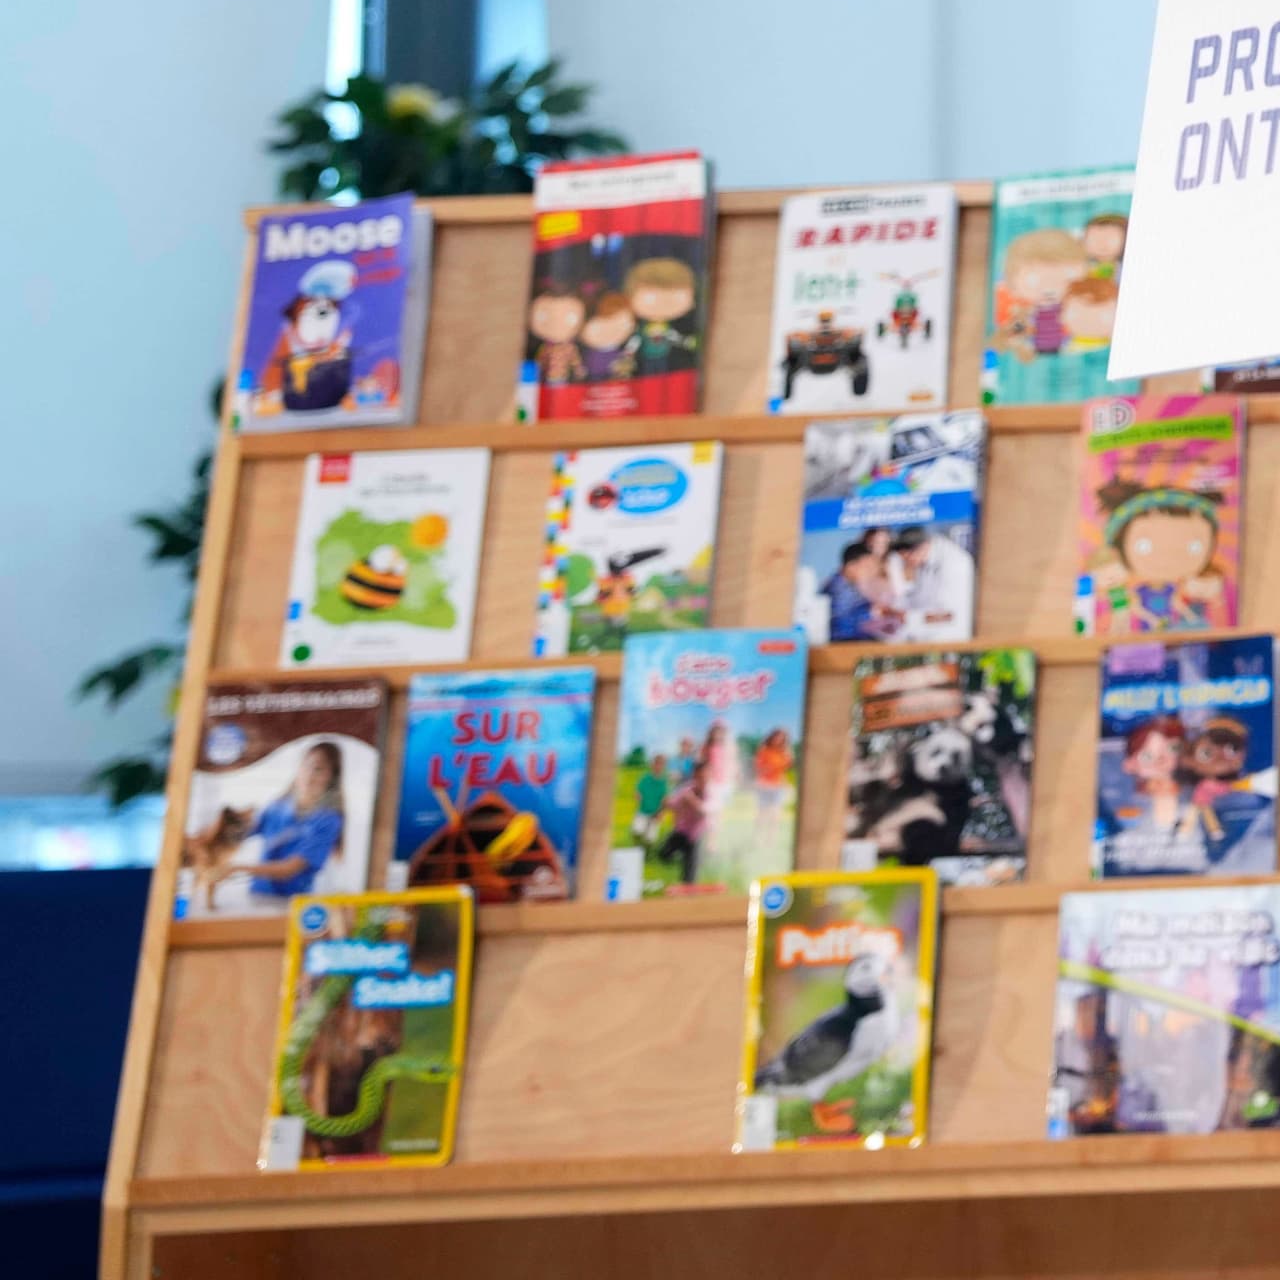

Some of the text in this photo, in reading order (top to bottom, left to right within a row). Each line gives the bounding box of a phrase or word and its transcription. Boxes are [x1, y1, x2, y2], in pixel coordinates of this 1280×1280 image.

[266, 215, 402, 262] Moose
[794, 217, 939, 250] RAPIDE
[453, 710, 541, 746] SUR
[428, 751, 557, 789] L'EAU
